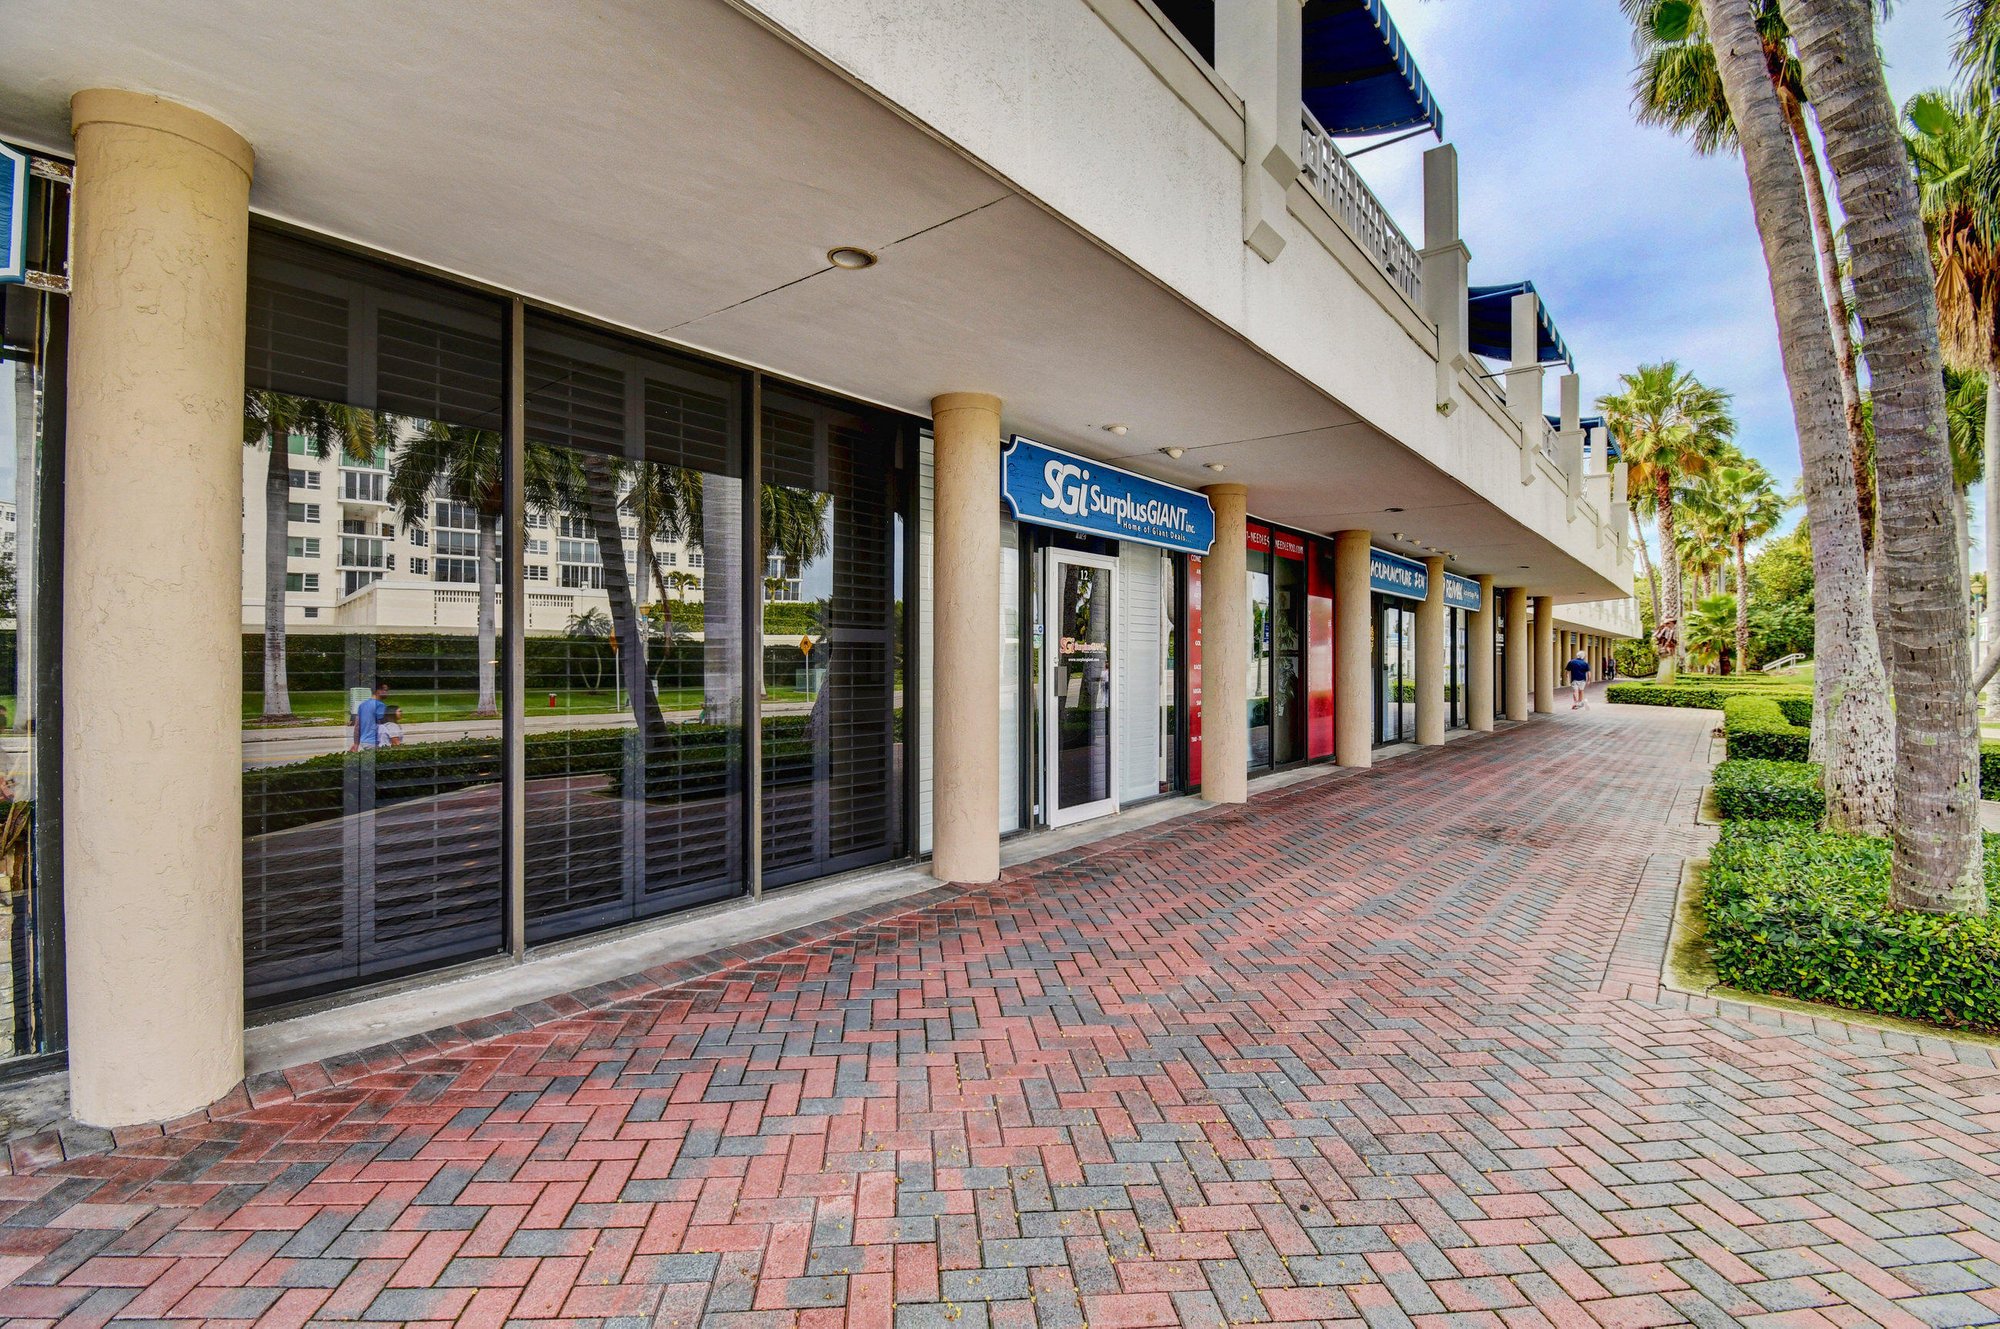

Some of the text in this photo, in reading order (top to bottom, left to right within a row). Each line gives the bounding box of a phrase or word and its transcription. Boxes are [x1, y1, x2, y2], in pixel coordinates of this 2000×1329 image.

[1041, 459, 1090, 517] SGi
[1090, 484, 1188, 531] SurplusGIANT
[1123, 521, 1141, 532] Home
[1143, 526, 1151, 534] of
[1152, 527, 1169, 539] Giant
[1080, 569, 1089, 580] 12
[1370, 559, 1412, 588] ACUPUNCTURE
